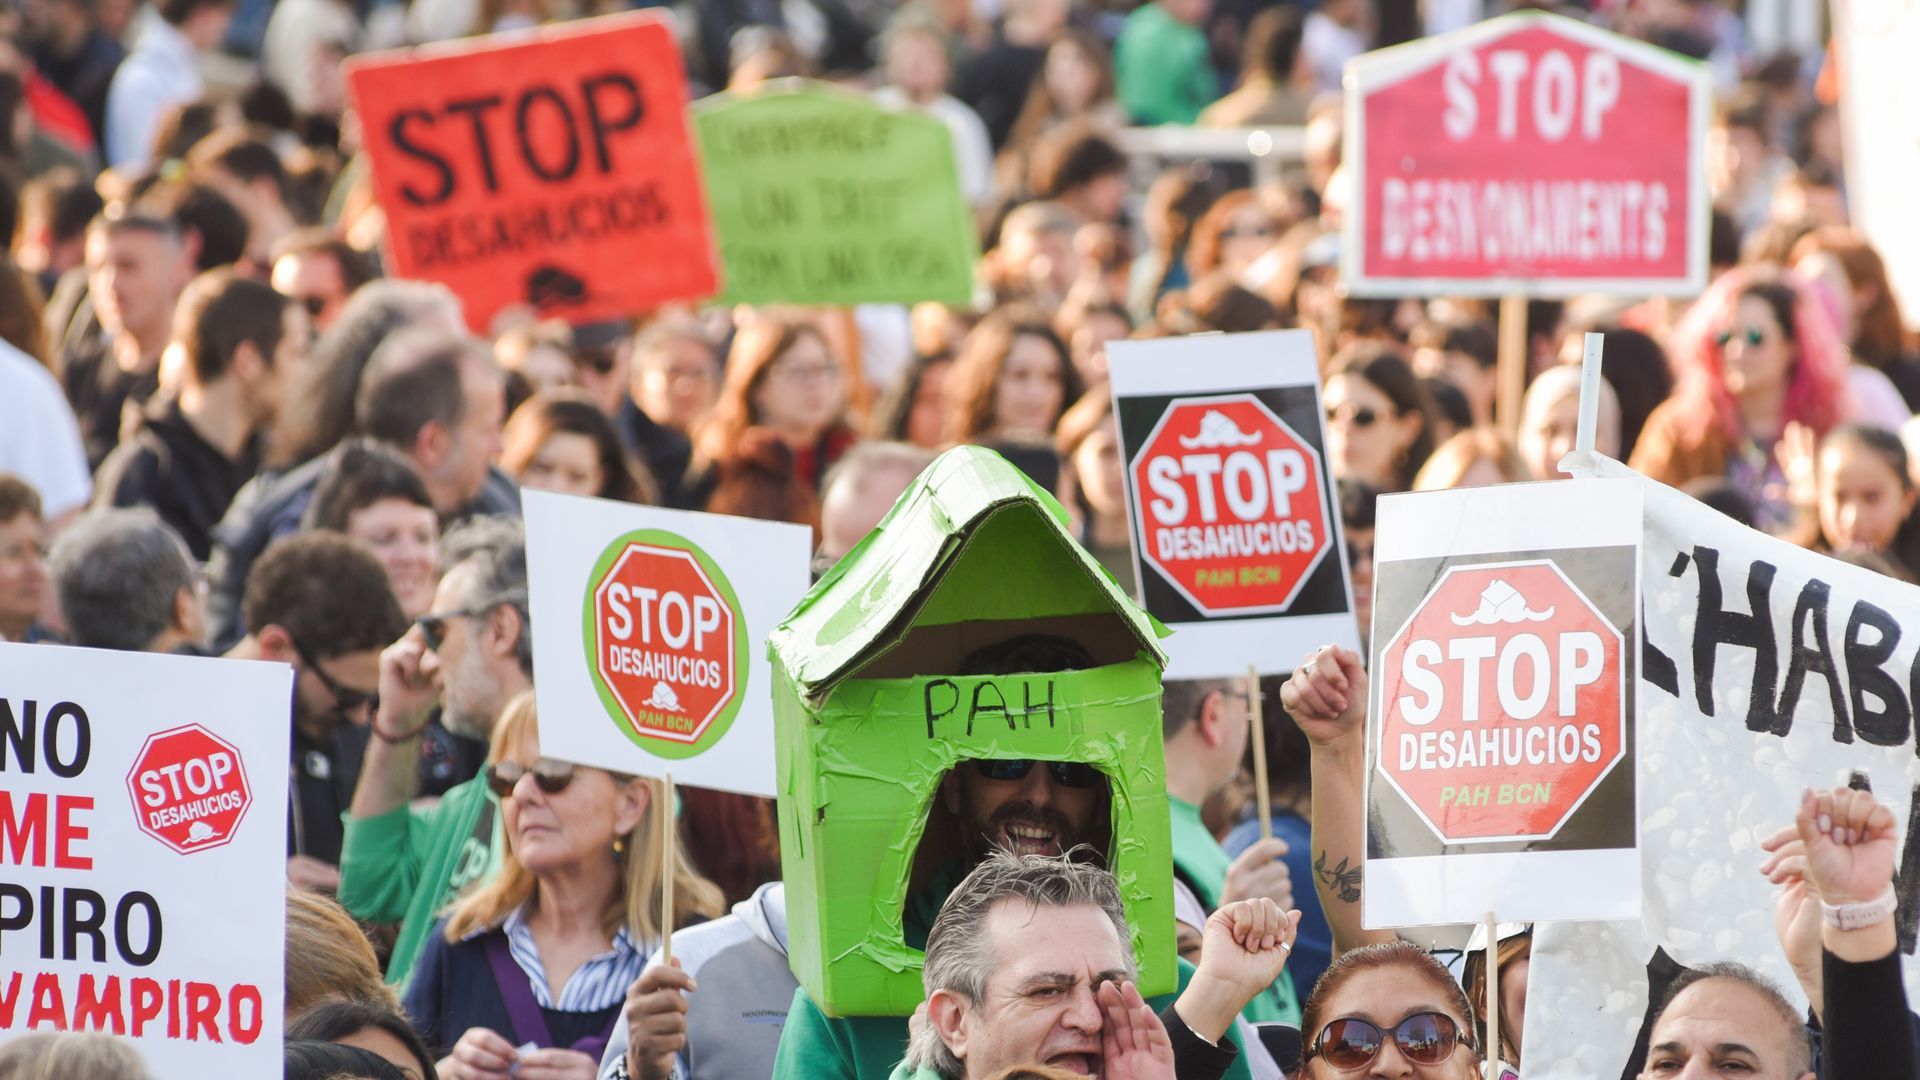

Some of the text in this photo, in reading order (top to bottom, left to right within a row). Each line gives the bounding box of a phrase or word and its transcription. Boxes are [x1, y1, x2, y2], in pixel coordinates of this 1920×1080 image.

[1443, 48, 1620, 141] STOP
[387, 73, 645, 206] STOP
[405, 181, 672, 269] DESAHUCIOS
[1147, 448, 1307, 525] STOP
[1156, 519, 1315, 561] DESAHUCIOS
[1195, 566, 1281, 587] PAH BCN
[606, 582, 720, 652] STOP
[609, 644, 721, 689] DESAHUCIOS
[1399, 630, 1605, 726] STOP
[0, 697, 91, 778] NO
[638, 710, 694, 732] PAH BCN
[924, 678, 1056, 739] PAH
[1399, 723, 1601, 772] DESAHUCIOS
[139, 752, 234, 808] STOP
[149, 790, 243, 831] DESAHUCIOS
[1439, 782, 1553, 808] PAH BCN
[0, 790, 94, 871] ME
